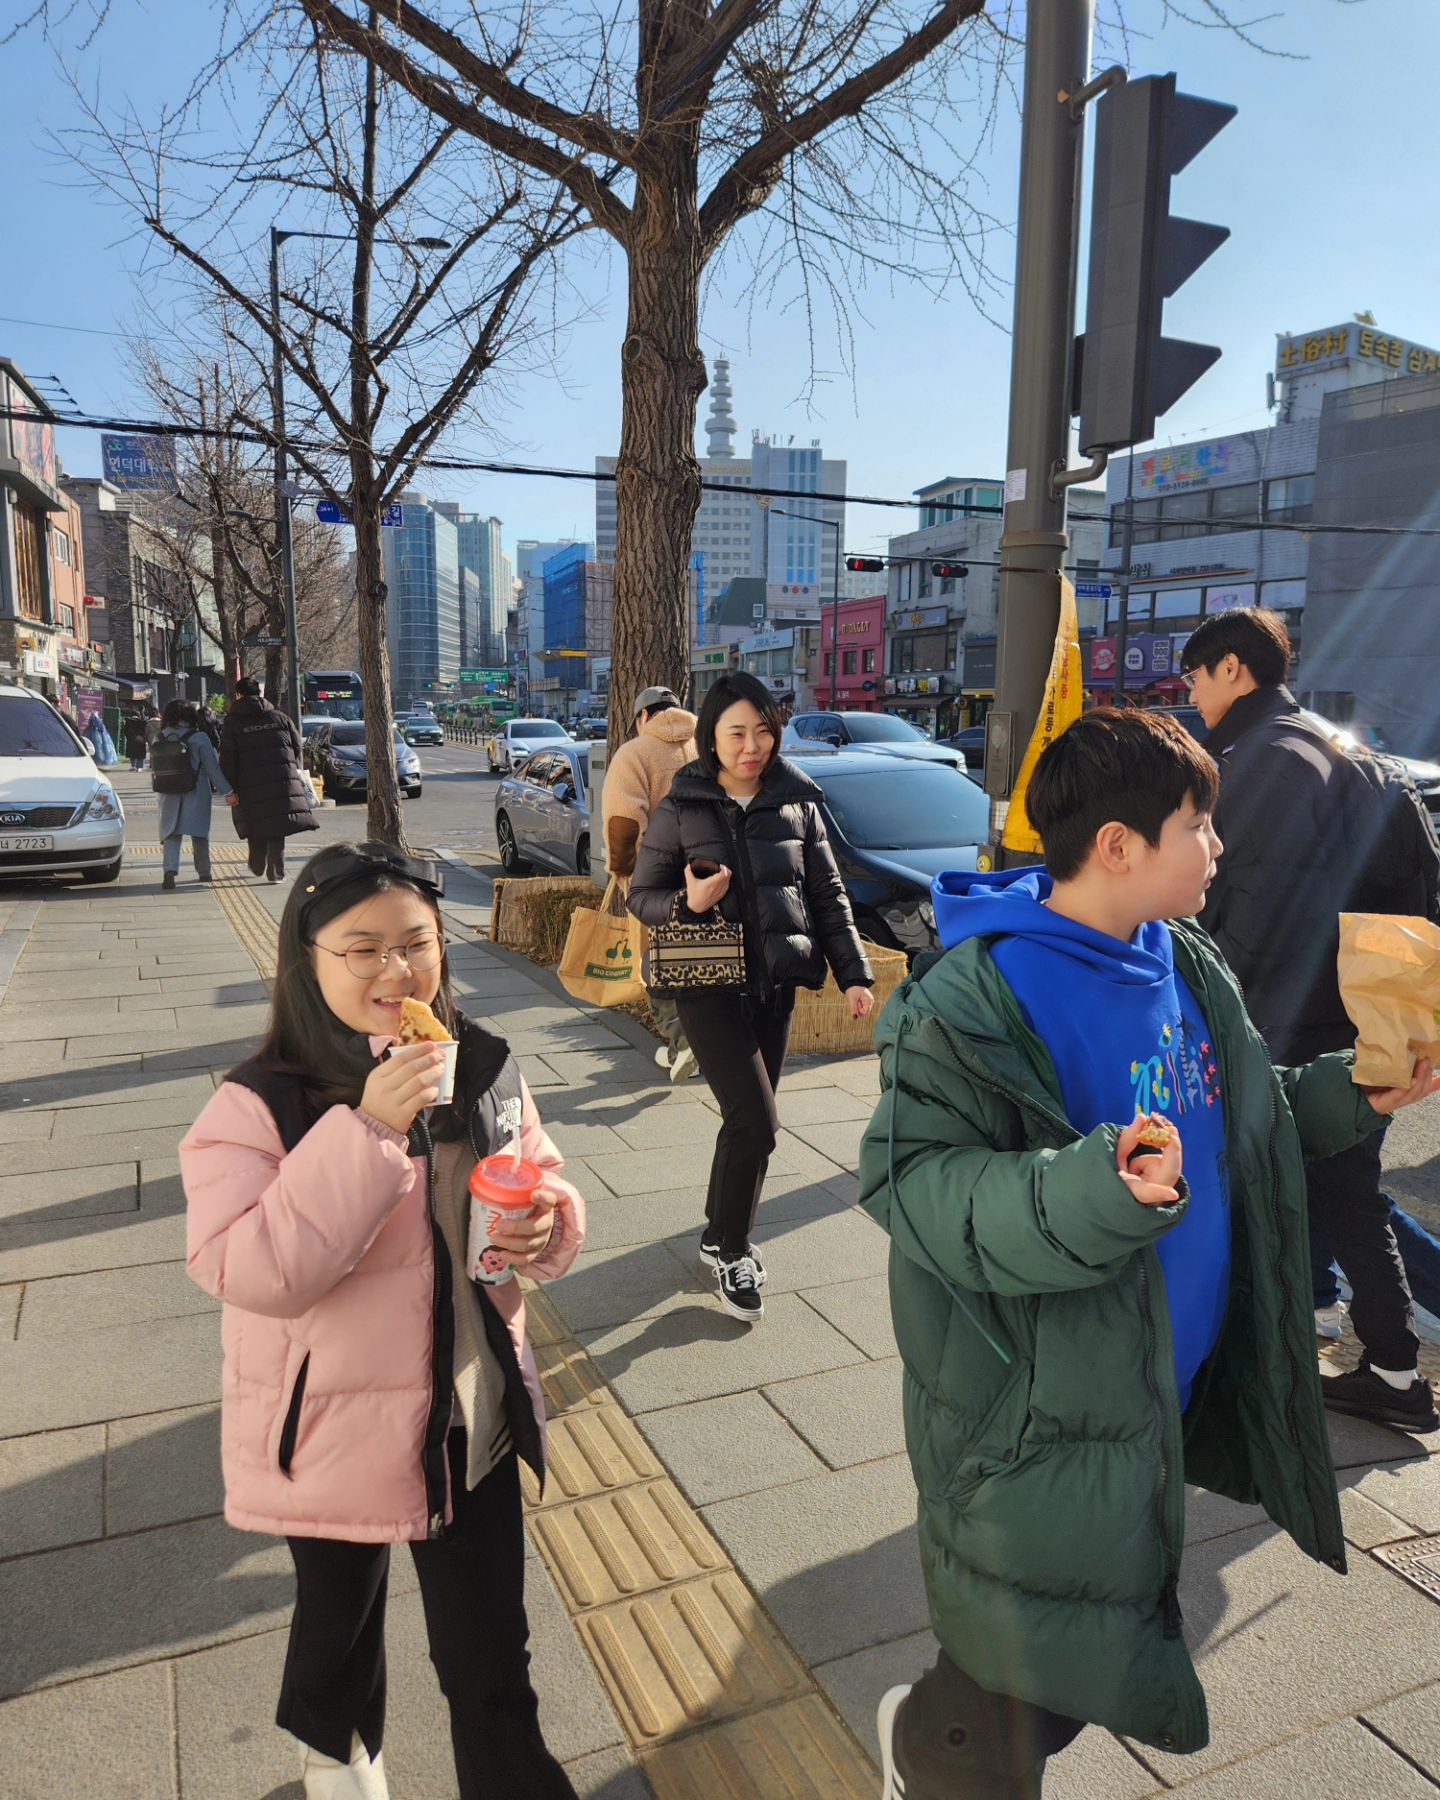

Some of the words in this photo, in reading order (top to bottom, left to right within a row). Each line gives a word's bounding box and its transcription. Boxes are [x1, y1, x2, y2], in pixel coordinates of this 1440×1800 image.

[1279, 330, 1347, 367] 土俗村
[1360, 329, 1403, 368] 토속촌
[1407, 347, 1440, 373] 삼계
[15, 838, 47, 850] 2723
